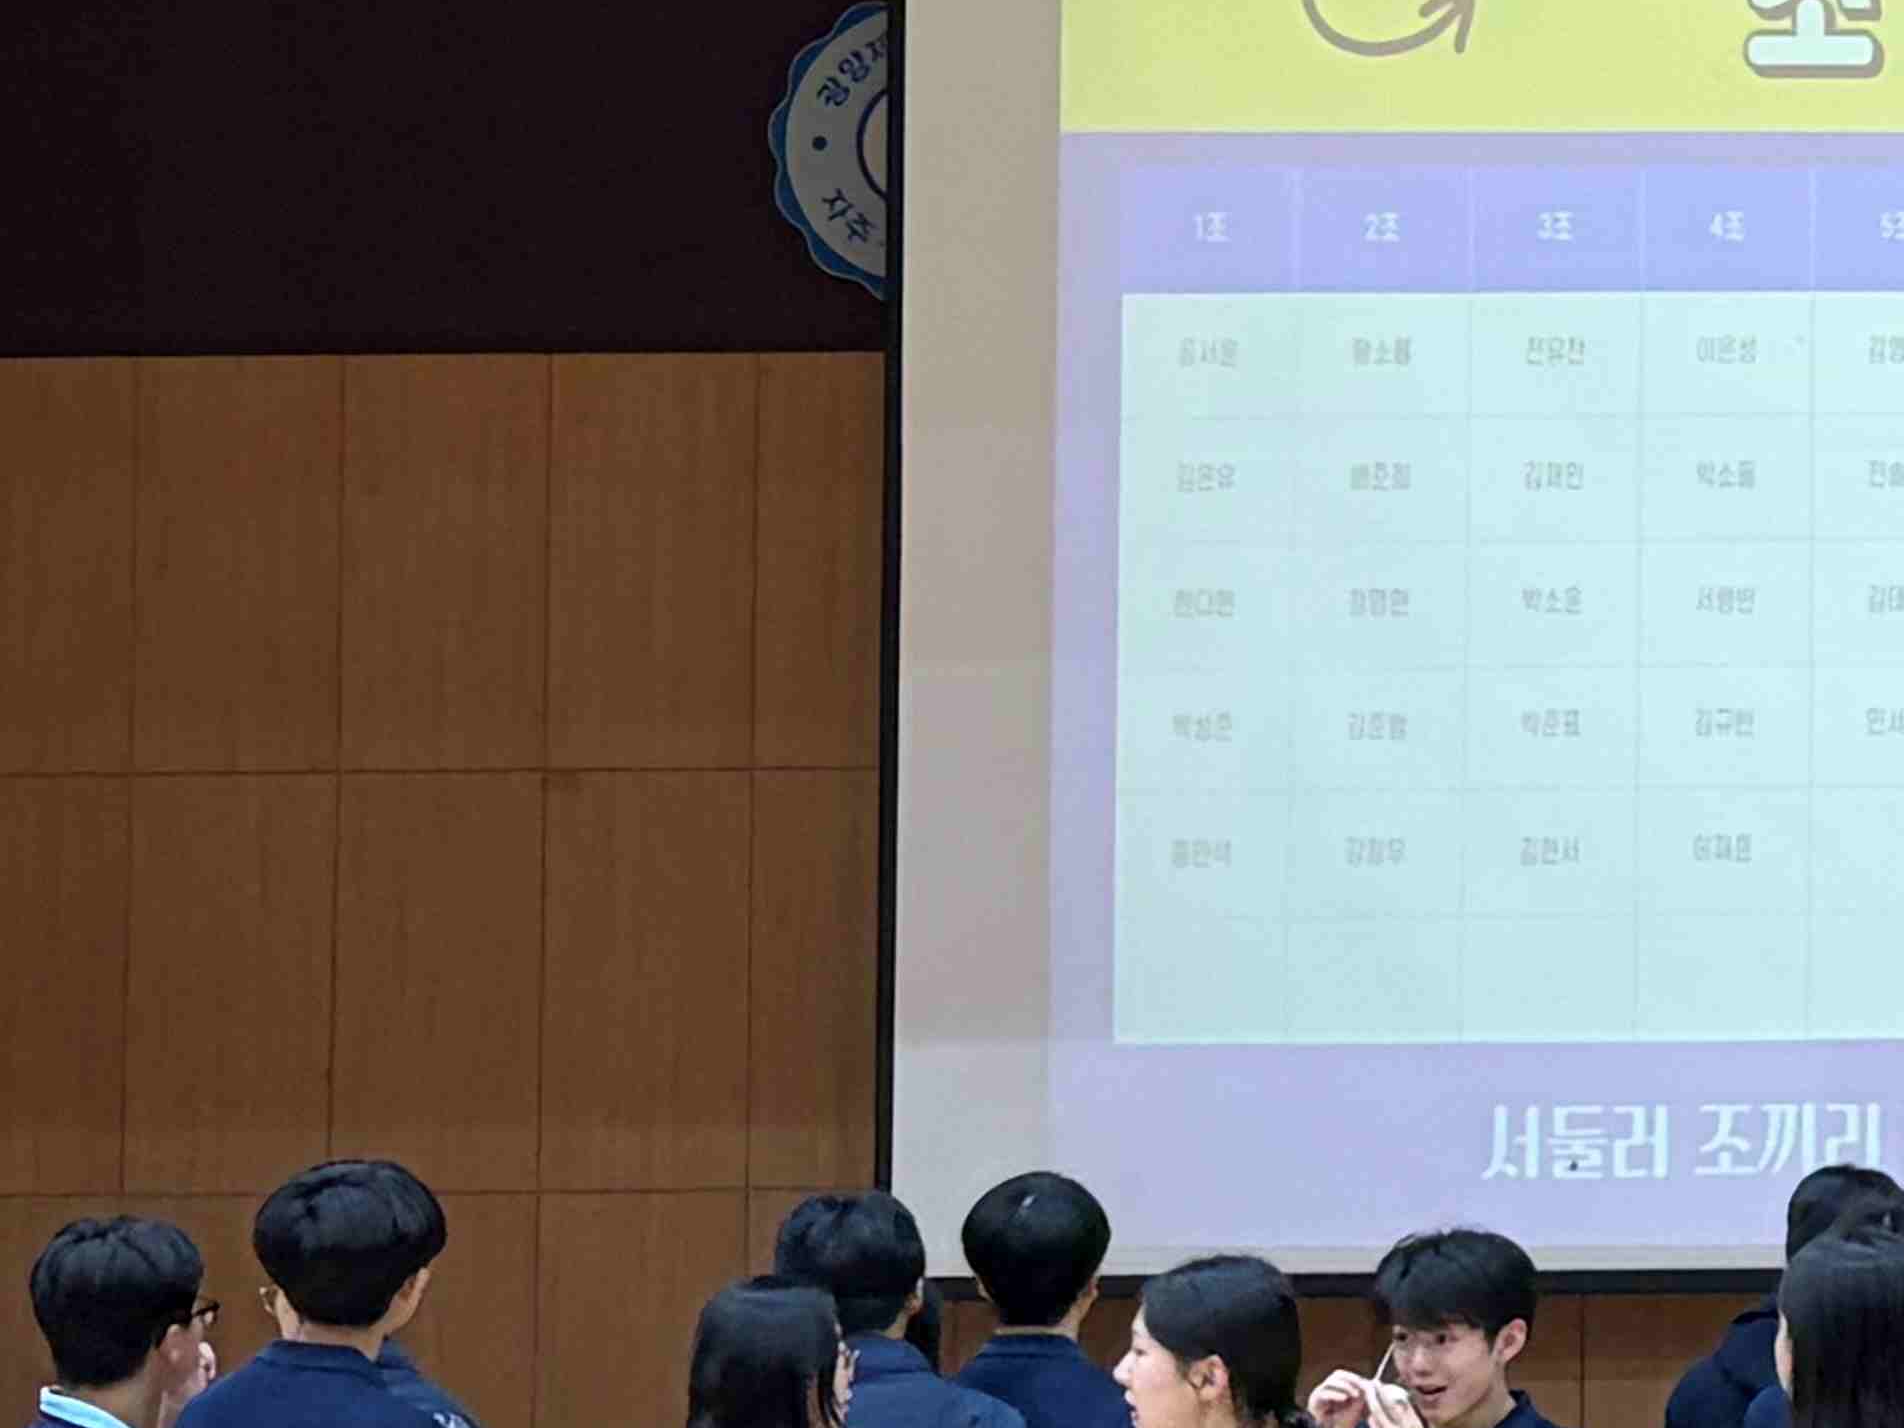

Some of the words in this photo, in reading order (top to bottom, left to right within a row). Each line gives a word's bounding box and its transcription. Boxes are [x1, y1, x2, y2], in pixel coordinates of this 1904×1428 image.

[1195, 212, 1226, 241] 1조
[1366, 212, 1398, 241] 2조
[1539, 212, 1572, 240] 3조
[1711, 212, 1743, 240] 4조
[1482, 1104, 1667, 1180] 서둘러
[1694, 1102, 1881, 1178] 조끼리
